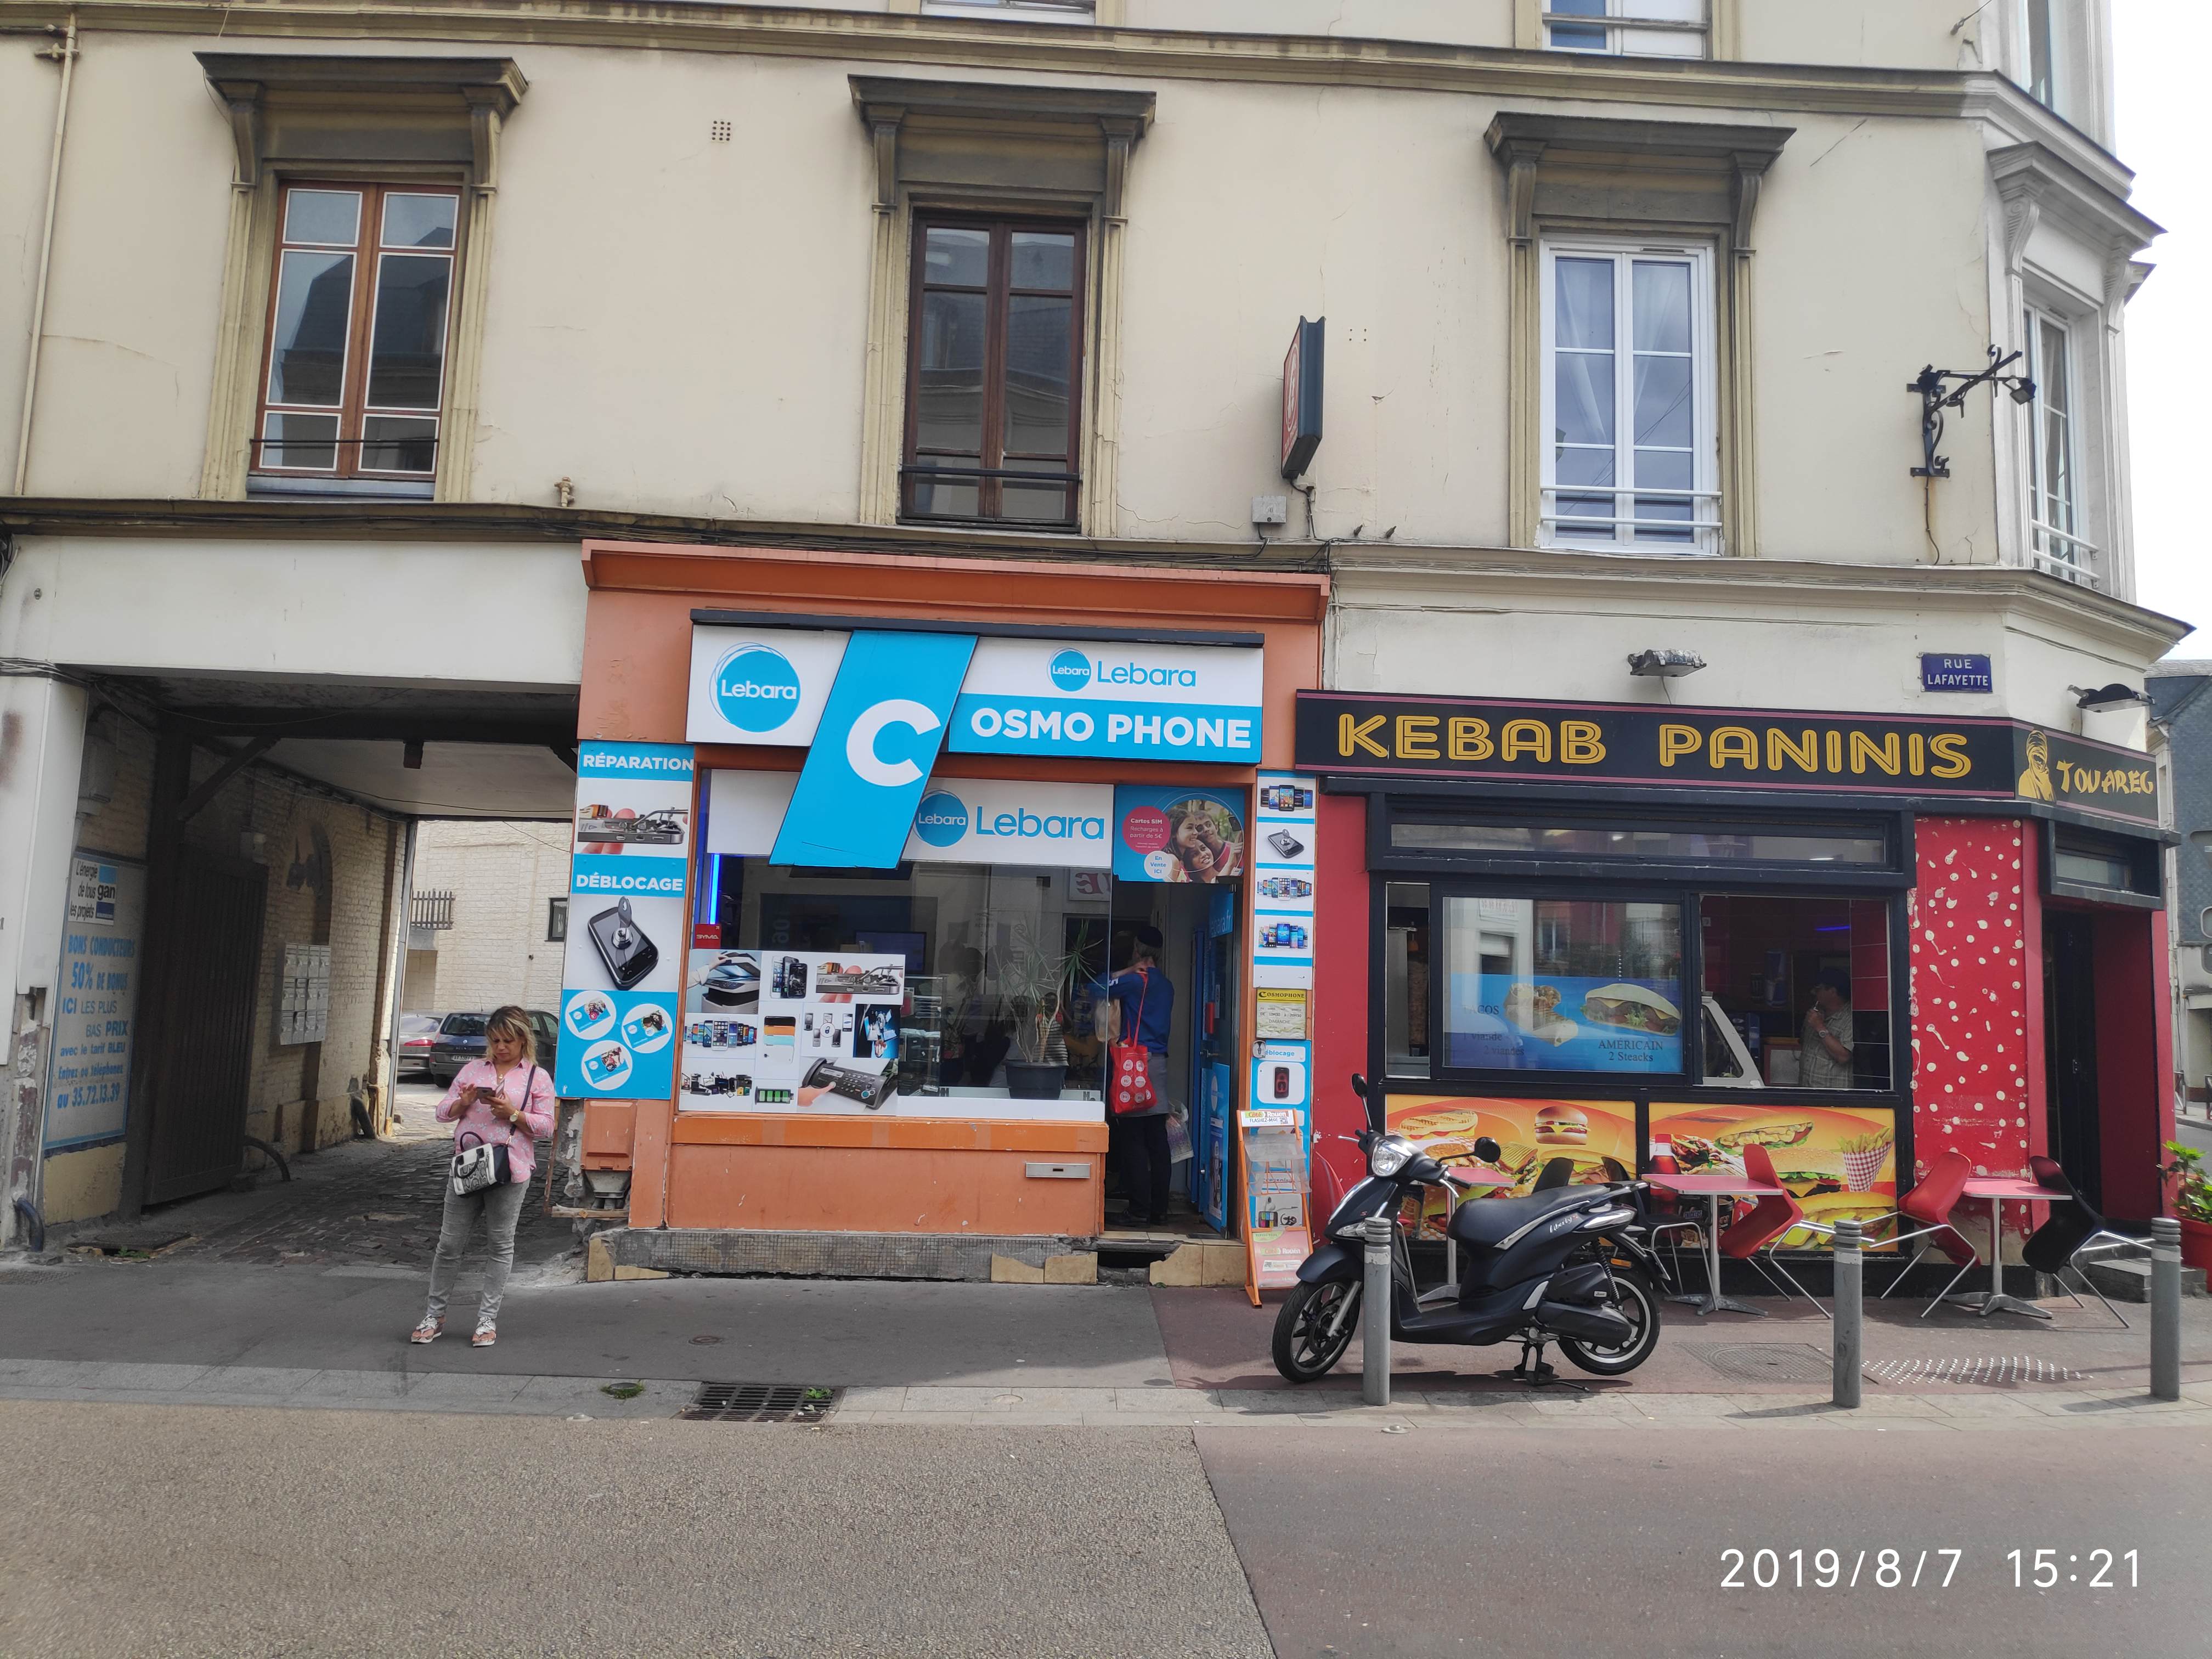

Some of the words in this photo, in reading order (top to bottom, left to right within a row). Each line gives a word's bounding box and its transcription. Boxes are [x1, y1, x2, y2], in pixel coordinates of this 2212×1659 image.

[1052, 665, 1090, 676] Lebara
[1944, 658, 1972, 669] RUE
[1097, 661, 1197, 687] Lebara
[1927, 674, 1988, 686] LAFAYETTE
[721, 679, 797, 700] Lebara
[971, 708, 1094, 741] OSMO
[1108, 714, 1251, 748] PHONE
[1339, 713, 1606, 764] KEBAB
[1659, 724, 1972, 778] PANINIS
[583, 752, 694, 771] RÉPARATION
[2056, 759, 2154, 794] TOUAREG
[918, 813, 966, 826] Lebara
[976, 806, 1105, 840] Lebara
[76, 860, 98, 881] L'énergie
[77, 881, 84, 896] de
[85, 882, 96, 899] tous
[576, 871, 684, 891] DÉBLOCAGE
[97, 884, 115, 901] gan
[76, 902, 94, 921] projets
[68, 934, 88, 954] BONS
[91, 935, 134, 958] CONDUCTEURS
[71, 962, 94, 990] 50%
[97, 972, 105, 990] DE
[107, 972, 128, 991] BONUS
[62, 997, 77, 1014] ICI
[81, 1000, 95, 1014] LES
[98, 1000, 117, 1014] PLUS
[1462, 1005, 1499, 1015] TACOS
[86, 1024, 101, 1037] BAS
[105, 1020, 128, 1036] PRIX
[1472, 1031, 1502, 1041] viande
[60, 1046, 78, 1057] avec
[81, 1044, 87, 1055] le
[91, 1042, 105, 1054] tarif
[108, 1042, 126, 1053] BLEU
[1491, 1046, 1525, 1056] viandes
[1598, 1037, 1663, 1050] AMÉRICAIN
[1609, 1051, 1614, 1060] 2
[1618, 1051, 1654, 1062] Steacks
[59, 1066, 78, 1080] Entrez
[81, 1067, 88, 1077] ou
[91, 1061, 123, 1081] téléphonez
[57, 1093, 69, 1109] au
